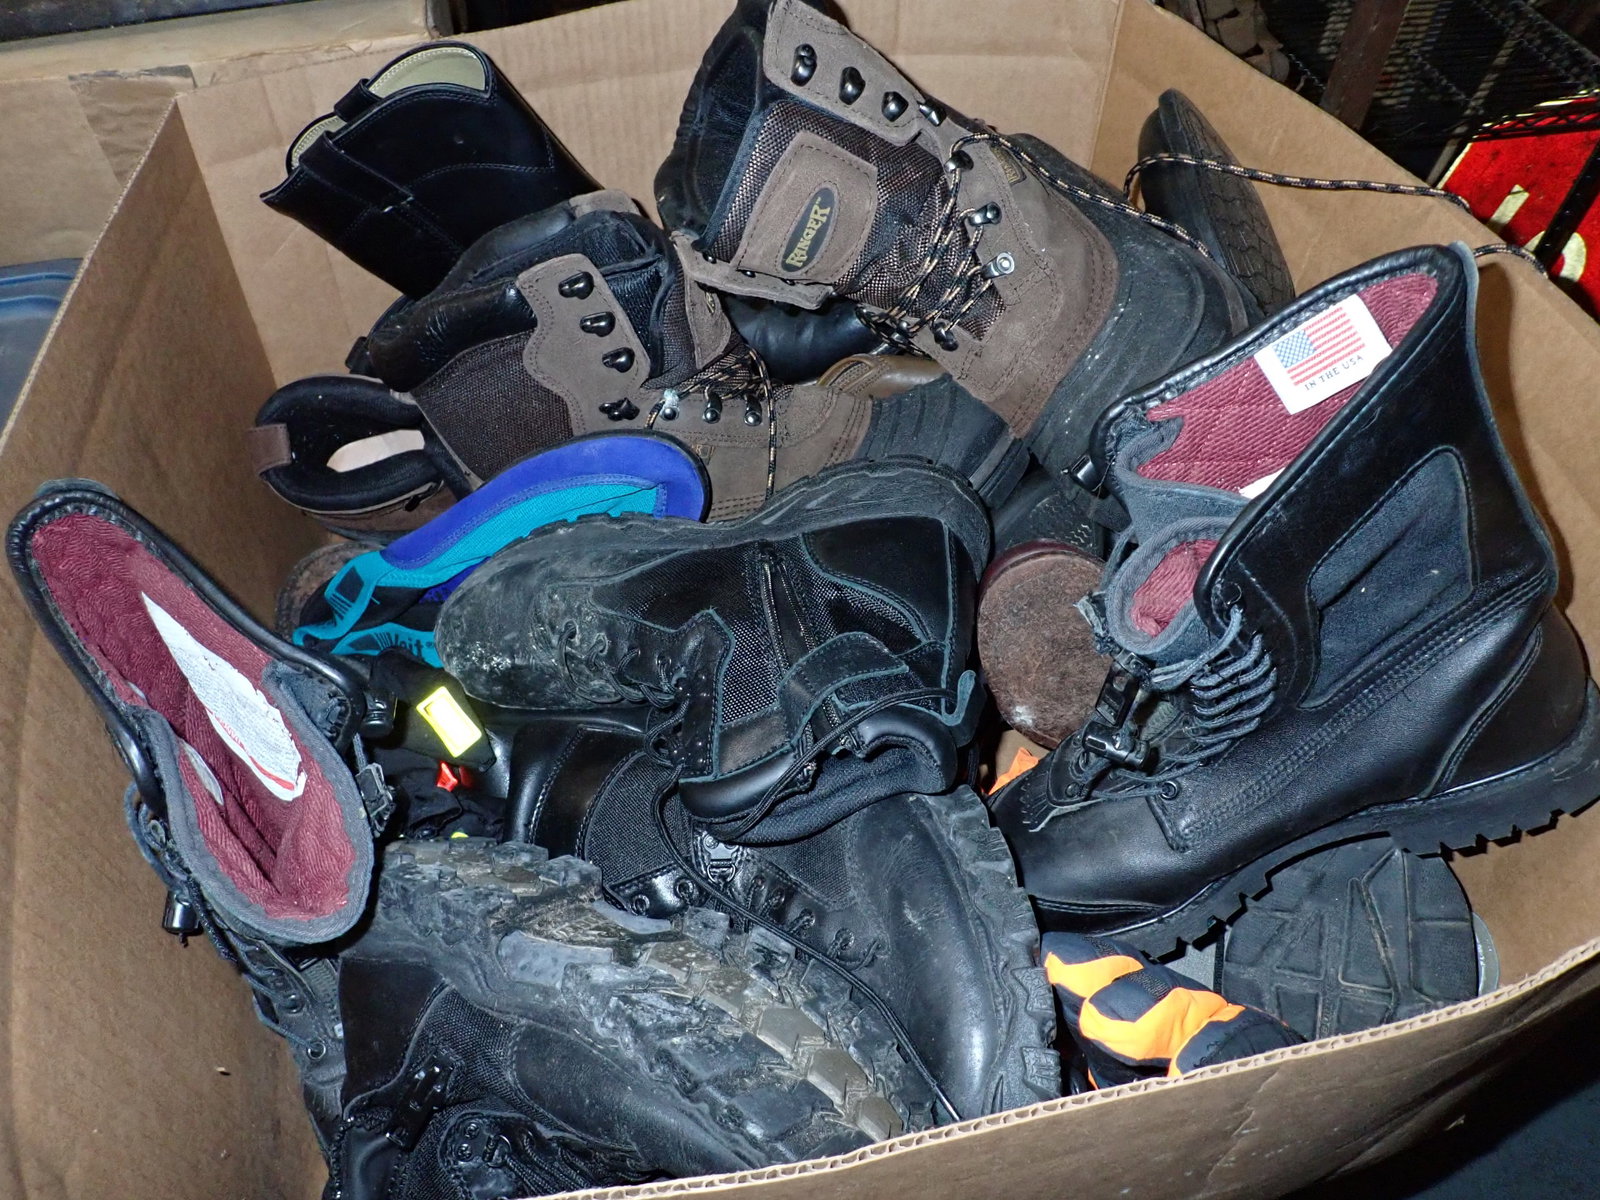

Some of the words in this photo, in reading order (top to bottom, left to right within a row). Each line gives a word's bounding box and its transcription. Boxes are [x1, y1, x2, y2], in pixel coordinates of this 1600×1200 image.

[1304, 380, 1317, 391] IN
[1319, 366, 1340, 383] THE
[1343, 354, 1364, 370] USA
